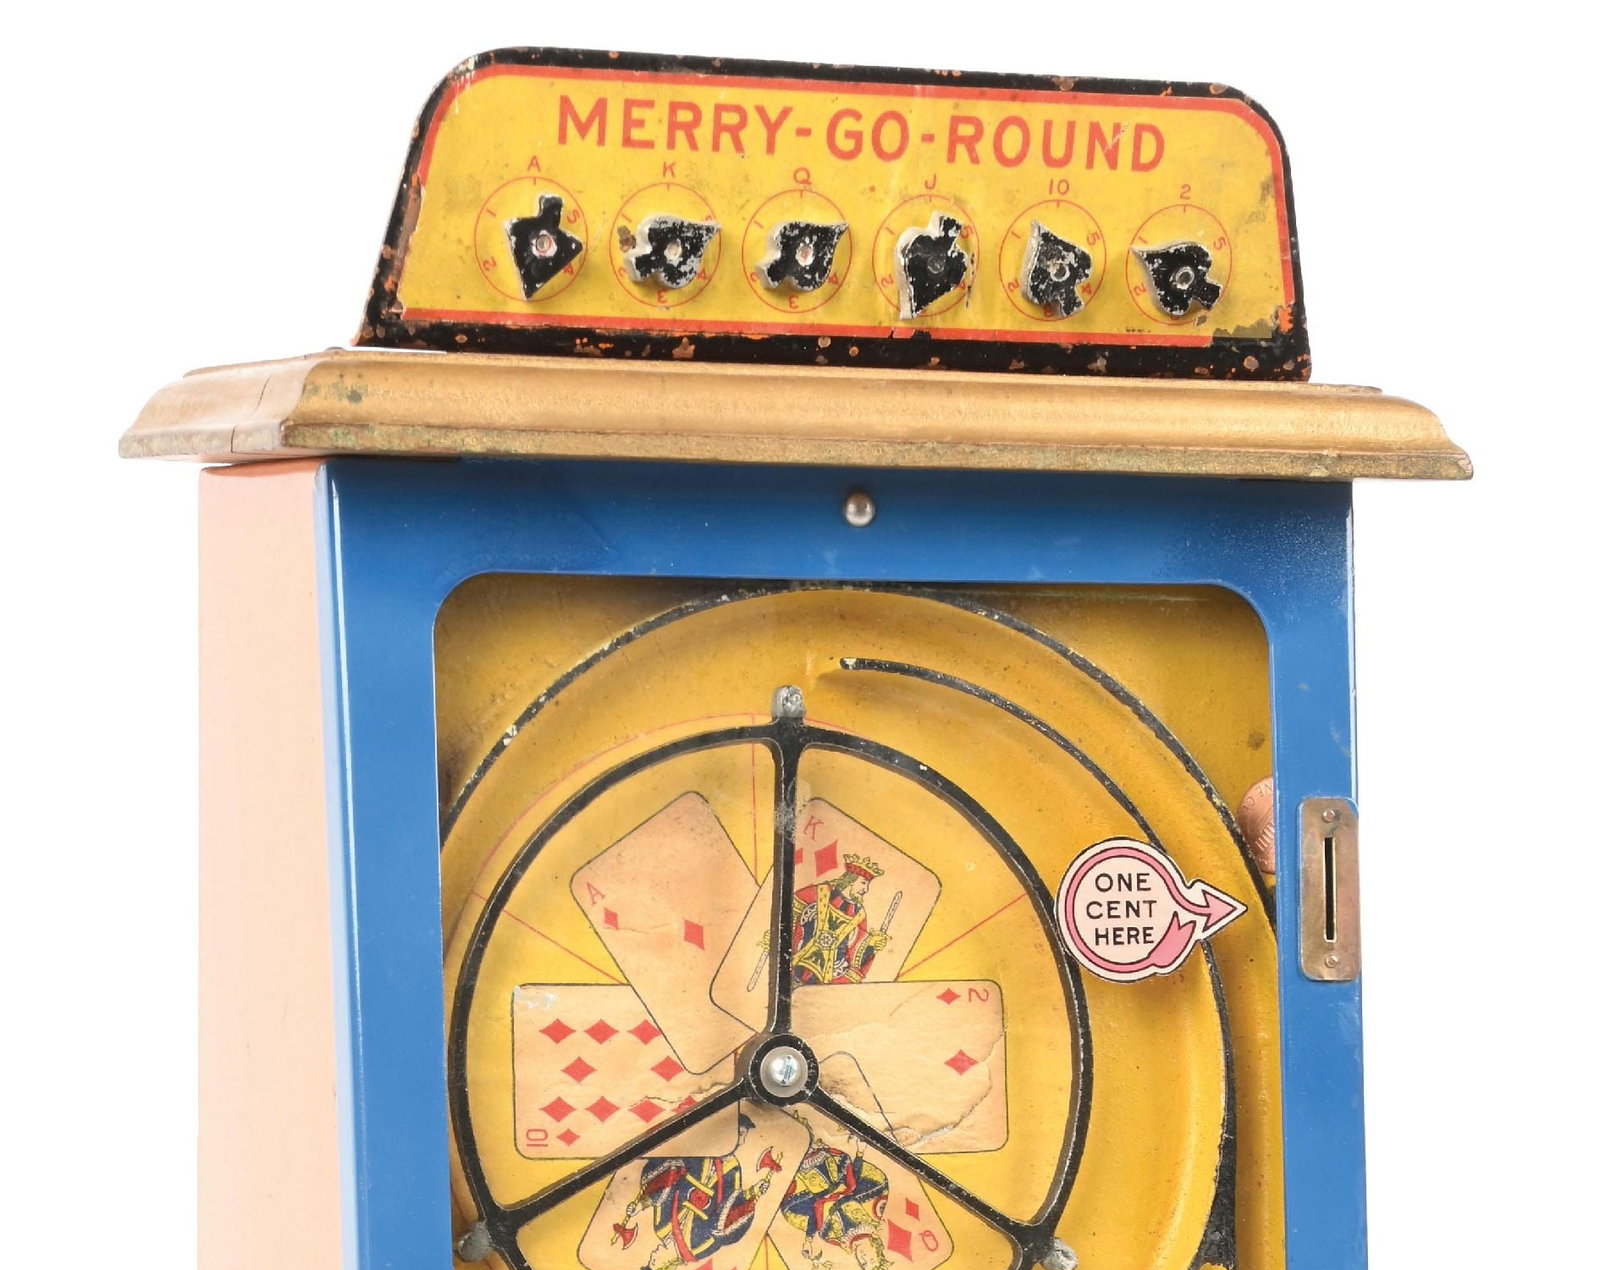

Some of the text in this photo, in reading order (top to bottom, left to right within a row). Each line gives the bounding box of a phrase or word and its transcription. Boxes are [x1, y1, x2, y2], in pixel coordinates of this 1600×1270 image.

[527, 155, 541, 172] A
[662, 161, 677, 178] K
[793, 167, 812, 186] Q
[924, 174, 937, 190] J
[1048, 179, 1070, 196] 10
[1180, 184, 1191, 200] 2
[1086, 231, 1100, 247] 5
[1213, 236, 1227, 251] 5
[802, 815, 824, 841] K
[1094, 872, 1151, 893] ONE
[586, 881, 606, 905] A
[1086, 900, 1157, 920] CENT
[1094, 926, 1155, 946] HERE
[968, 987, 990, 1003] 2
[526, 1128, 549, 1148] 10
[918, 1229, 939, 1252] Q
